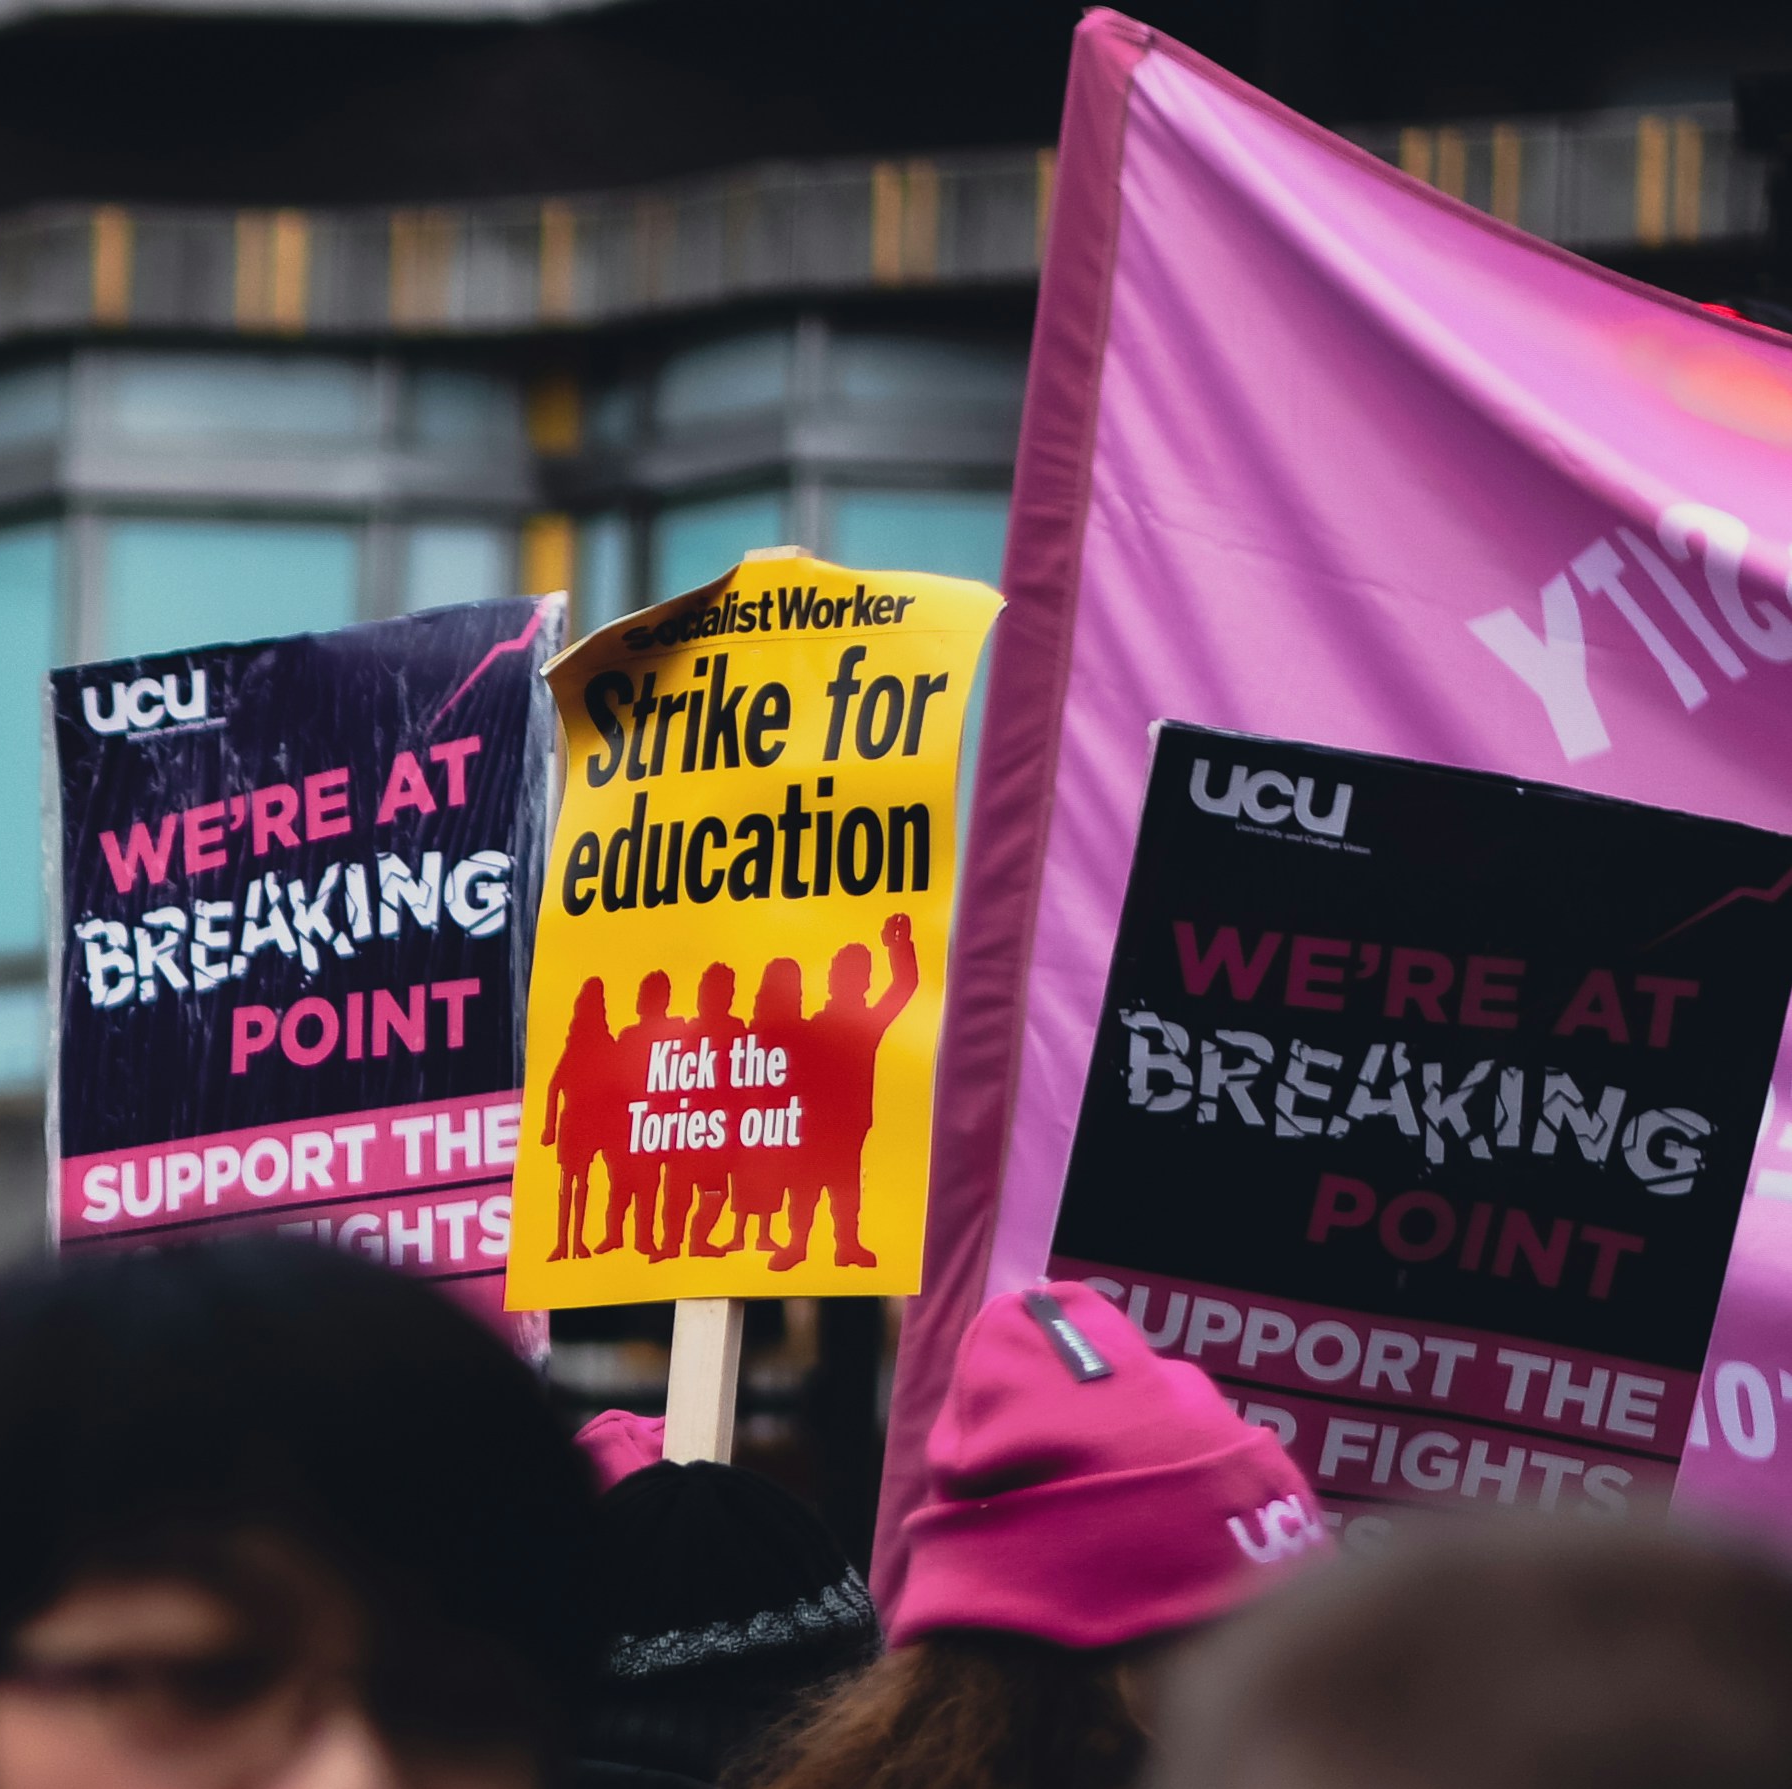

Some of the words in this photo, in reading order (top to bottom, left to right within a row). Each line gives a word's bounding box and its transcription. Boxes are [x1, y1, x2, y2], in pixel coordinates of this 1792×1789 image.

[778, 583, 917, 631] Worker
[82, 669, 207, 734] UCU
[583, 652, 792, 789] Strike
[823, 645, 950, 763] for
[99, 767, 353, 895] WE'RE
[375, 736, 483, 826] AT
[1189, 757, 1354, 838] UCU
[562, 780, 931, 918] education
[74, 850, 513, 1006] BREAKING
[230, 977, 482, 1076] POINT
[1173, 920, 1525, 1029] WE'RE
[1555, 968, 1700, 1049] AT
[646, 1036, 718, 1094] Kick
[729, 1033, 788, 1089] the
[1119, 1000, 1718, 1196] BREAKING
[82, 1122, 378, 1224] SUPPORT
[391, 1101, 521, 1176] THE
[628, 1097, 727, 1155] Tories
[739, 1094, 803, 1148] out
[276, 1195, 514, 1267] GHTS
[1306, 1173, 1645, 1300] POINT
[1495, 1348, 1667, 1440] THE
[1318, 1416, 1634, 1516] FIGHTS
